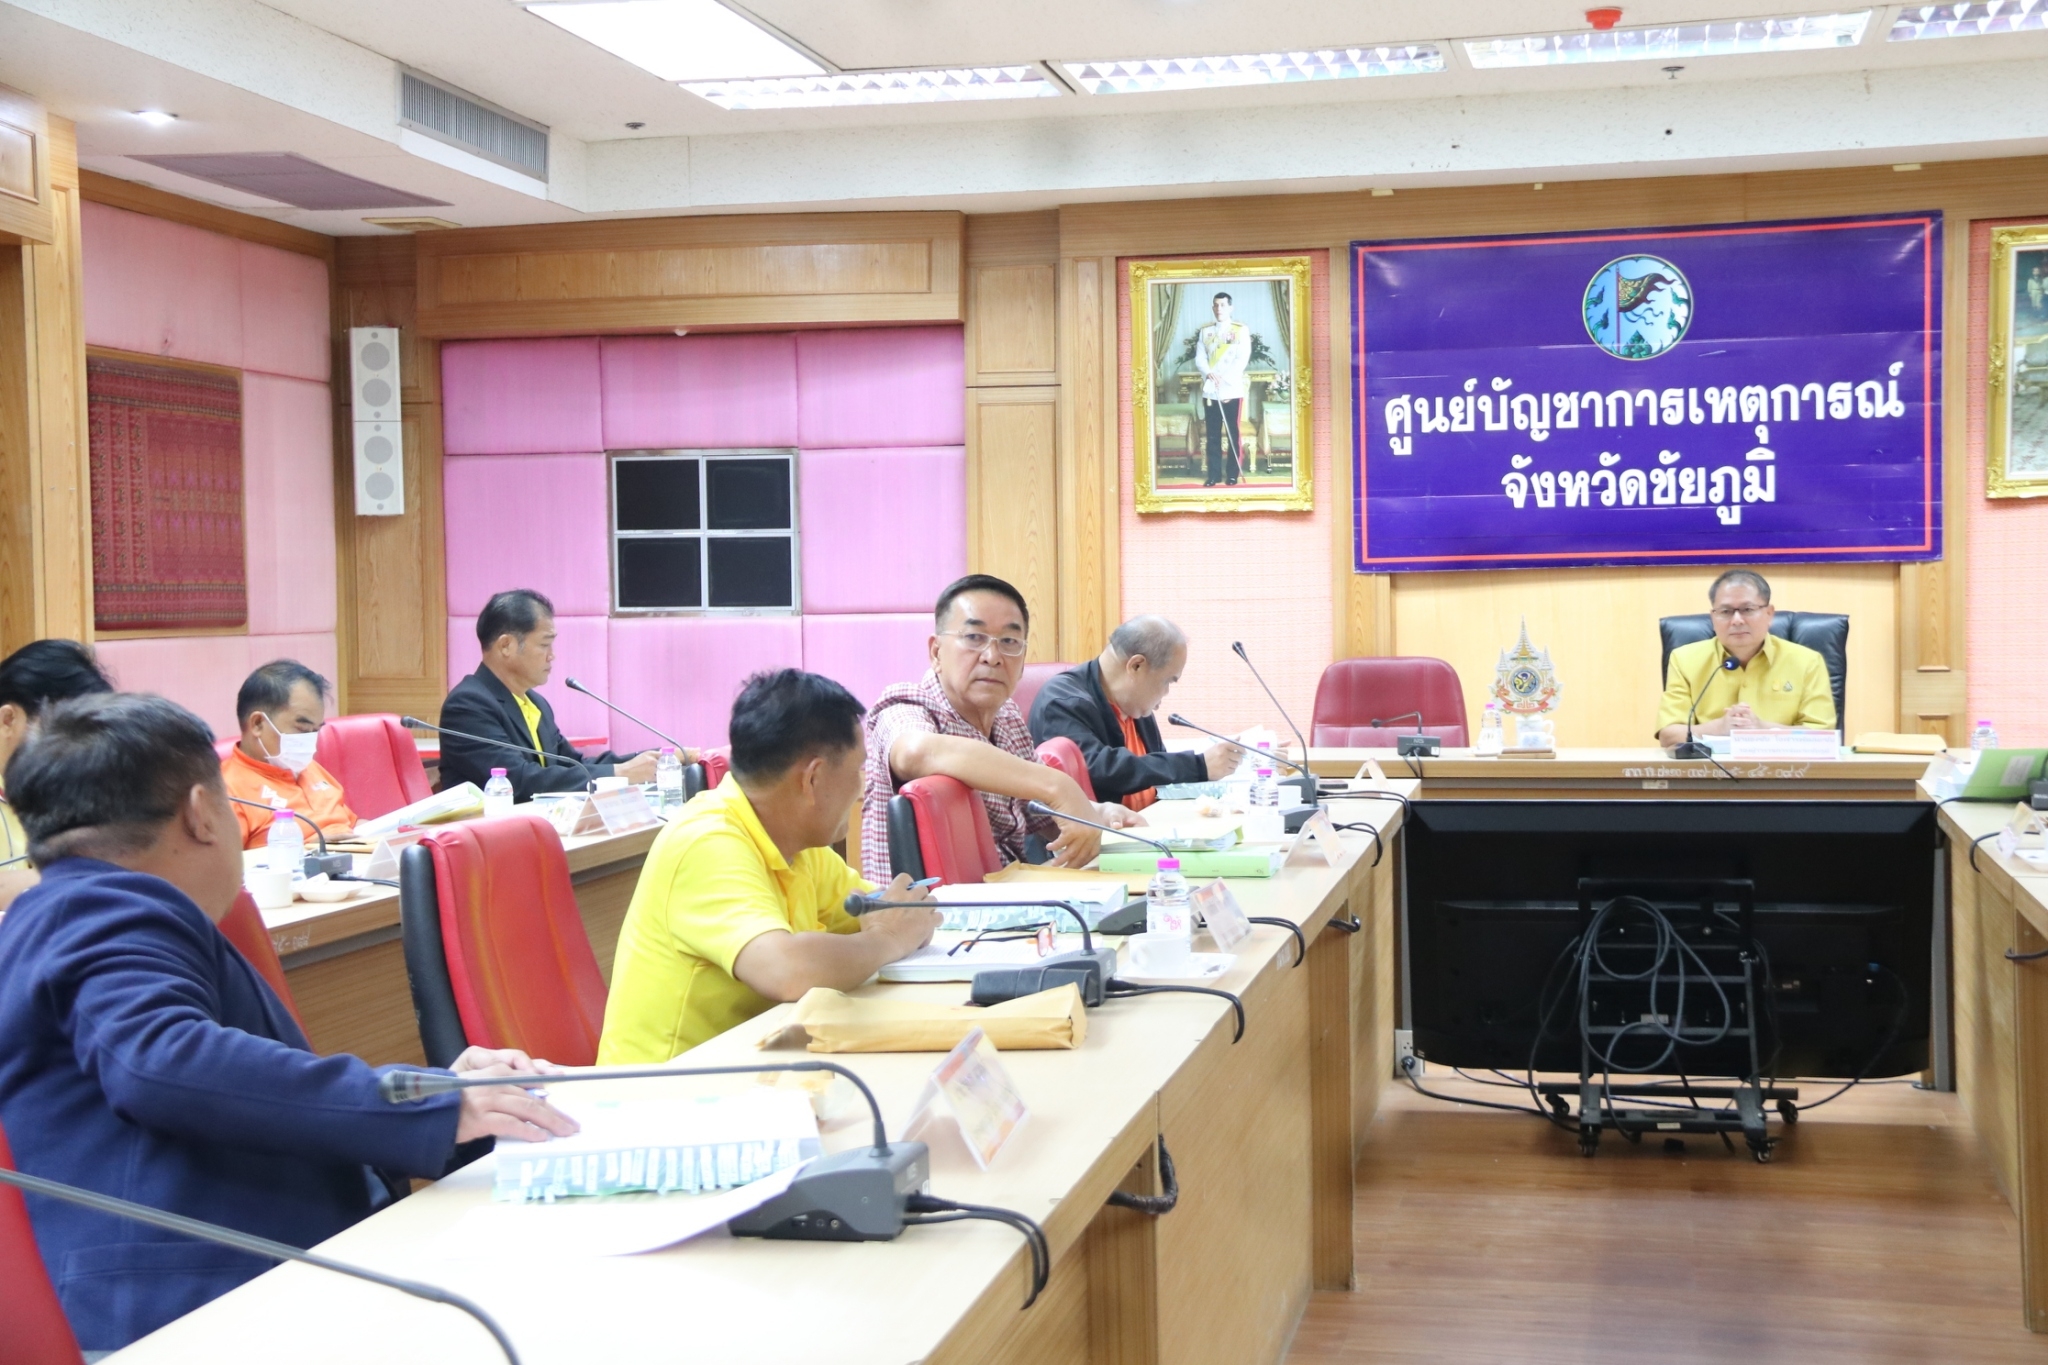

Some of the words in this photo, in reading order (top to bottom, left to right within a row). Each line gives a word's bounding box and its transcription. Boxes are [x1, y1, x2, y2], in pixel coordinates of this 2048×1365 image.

[1384, 361, 1906, 456] ศูนย์บัญชาการเหตุการณ์
[1500, 446, 1776, 526] จังหวัดชัยภูมิ
